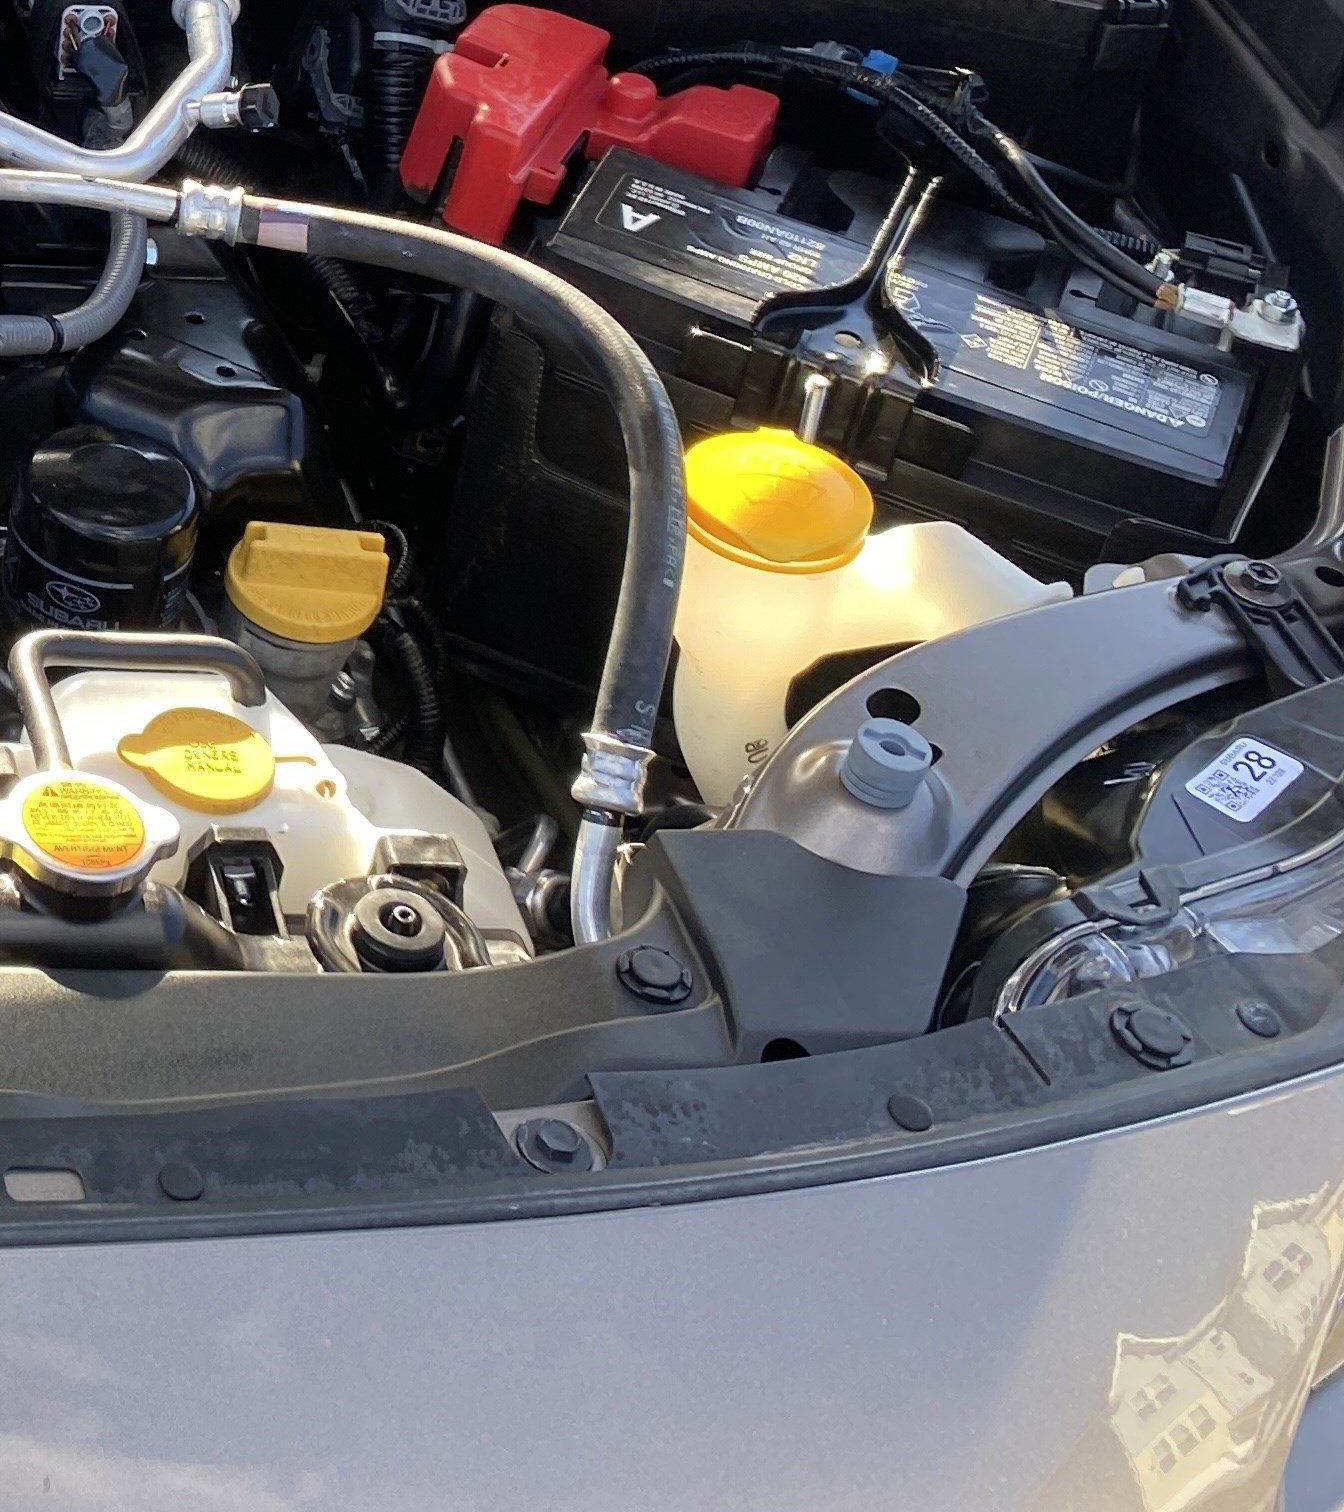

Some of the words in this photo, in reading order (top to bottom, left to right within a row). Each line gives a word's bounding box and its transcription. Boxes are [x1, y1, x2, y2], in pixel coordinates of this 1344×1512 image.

[621, 201, 662, 233] A
[686, 244, 717, 265] AMPS
[716, 254, 774, 280] CRANKING
[737, 253, 782, 275] AMPS
[26, 590, 121, 631] SUBARU
[1231, 749, 1277, 783] 28
